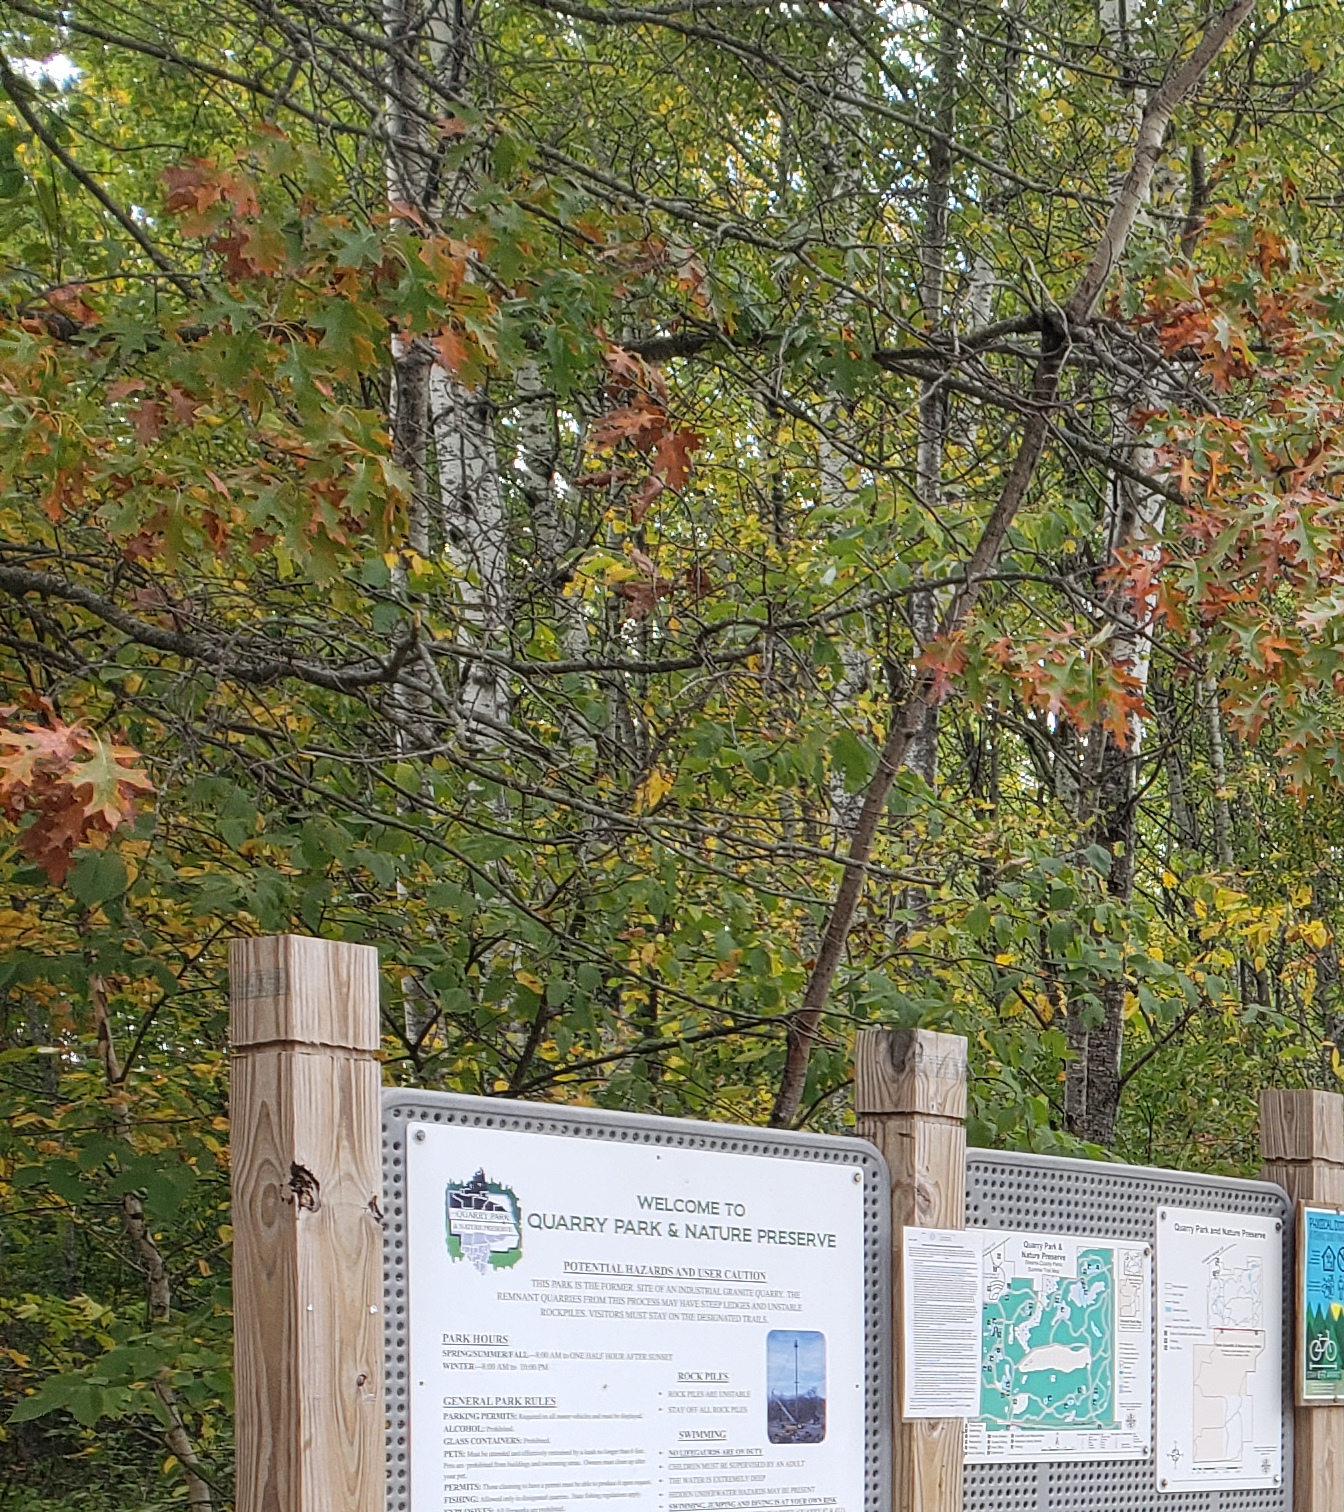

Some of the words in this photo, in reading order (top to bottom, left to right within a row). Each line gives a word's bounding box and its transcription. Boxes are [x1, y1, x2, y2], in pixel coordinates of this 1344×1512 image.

[637, 1195, 720, 1215] WELCOME
[724, 1202, 746, 1217] TO
[456, 1211, 488, 1220] QUARRY
[527, 1213, 608, 1233] QUARRY
[614, 1219, 662, 1237] PARK
[668, 1223, 679, 1238] &
[685, 1224, 752, 1243] NATURE
[757, 1229, 837, 1248] PRESERVE
[1174, 1222, 1195, 1235] Quarry
[1195, 1224, 1208, 1234] Park
[1210, 1227, 1221, 1235] and
[1222, 1228, 1241, 1237] Nature
[1241, 1229, 1266, 1240] Preserve
[1023, 1240, 1043, 1251] Quarry
[1044, 1242, 1057, 1250] Park
[1021, 1251, 1040, 1259] Nature
[1041, 1252, 1066, 1261] Preserve
[563, 1261, 624, 1274] POTENTIAL
[625, 1264, 674, 1276] HAZARDS
[676, 1267, 696, 1277] AND
[698, 1268, 722, 1279] USER
[724, 1269, 766, 1281] CAUTION
[531, 1279, 550, 1288] THIS
[551, 1280, 573, 1289] PARK
[575, 1281, 582, 1289] IS
[583, 1281, 600, 1290] THE
[601, 1282, 633, 1291] FORMER
[637, 1283, 654, 1292] SITE
[655, 1284, 664, 1293] OF
[666, 1285, 677, 1294] AN
[679, 1286, 722, 1296] INDUSTRIAL
[723, 1288, 754, 1297] GRANITE
[497, 1292, 539, 1302] REMNANT
[540, 1294, 582, 1304] QUARRIES
[583, 1295, 606, 1304] FROM
[608, 1296, 625, 1305] THIS
[627, 1297, 660, 1306] PROCESS
[661, 1298, 678, 1307] MAY
[680, 1299, 699, 1308] HAVE
[701, 1300, 723, 1309] STEEP
[723, 1301, 750, 1310] LEDGES
[752, 1302, 767, 1310] AND
[768, 1303, 802, 1312] UNSTABLE
[588, 1309, 624, 1318] VISITORS
[626, 1311, 647, 1319] MUST
[649, 1312, 667, 1320] STAY
[668, 1312, 679, 1321] ON
[680, 1313, 696, 1321] THE
[697, 1313, 741, 1322] DESIGNATED
[442, 1333, 470, 1343] PARK
[473, 1334, 509, 1344] HOURS
[677, 1372, 703, 1381] ROCK
[704, 1372, 730, 1381] PILES
[443, 1396, 493, 1405] GENERAL
[495, 1396, 522, 1405] PARK
[524, 1396, 556, 1406] RULES
[443, 1412, 480, 1420] PARKING
[678, 1430, 727, 1440] SWIMMING
[443, 1437, 469, 1445] GLASS
